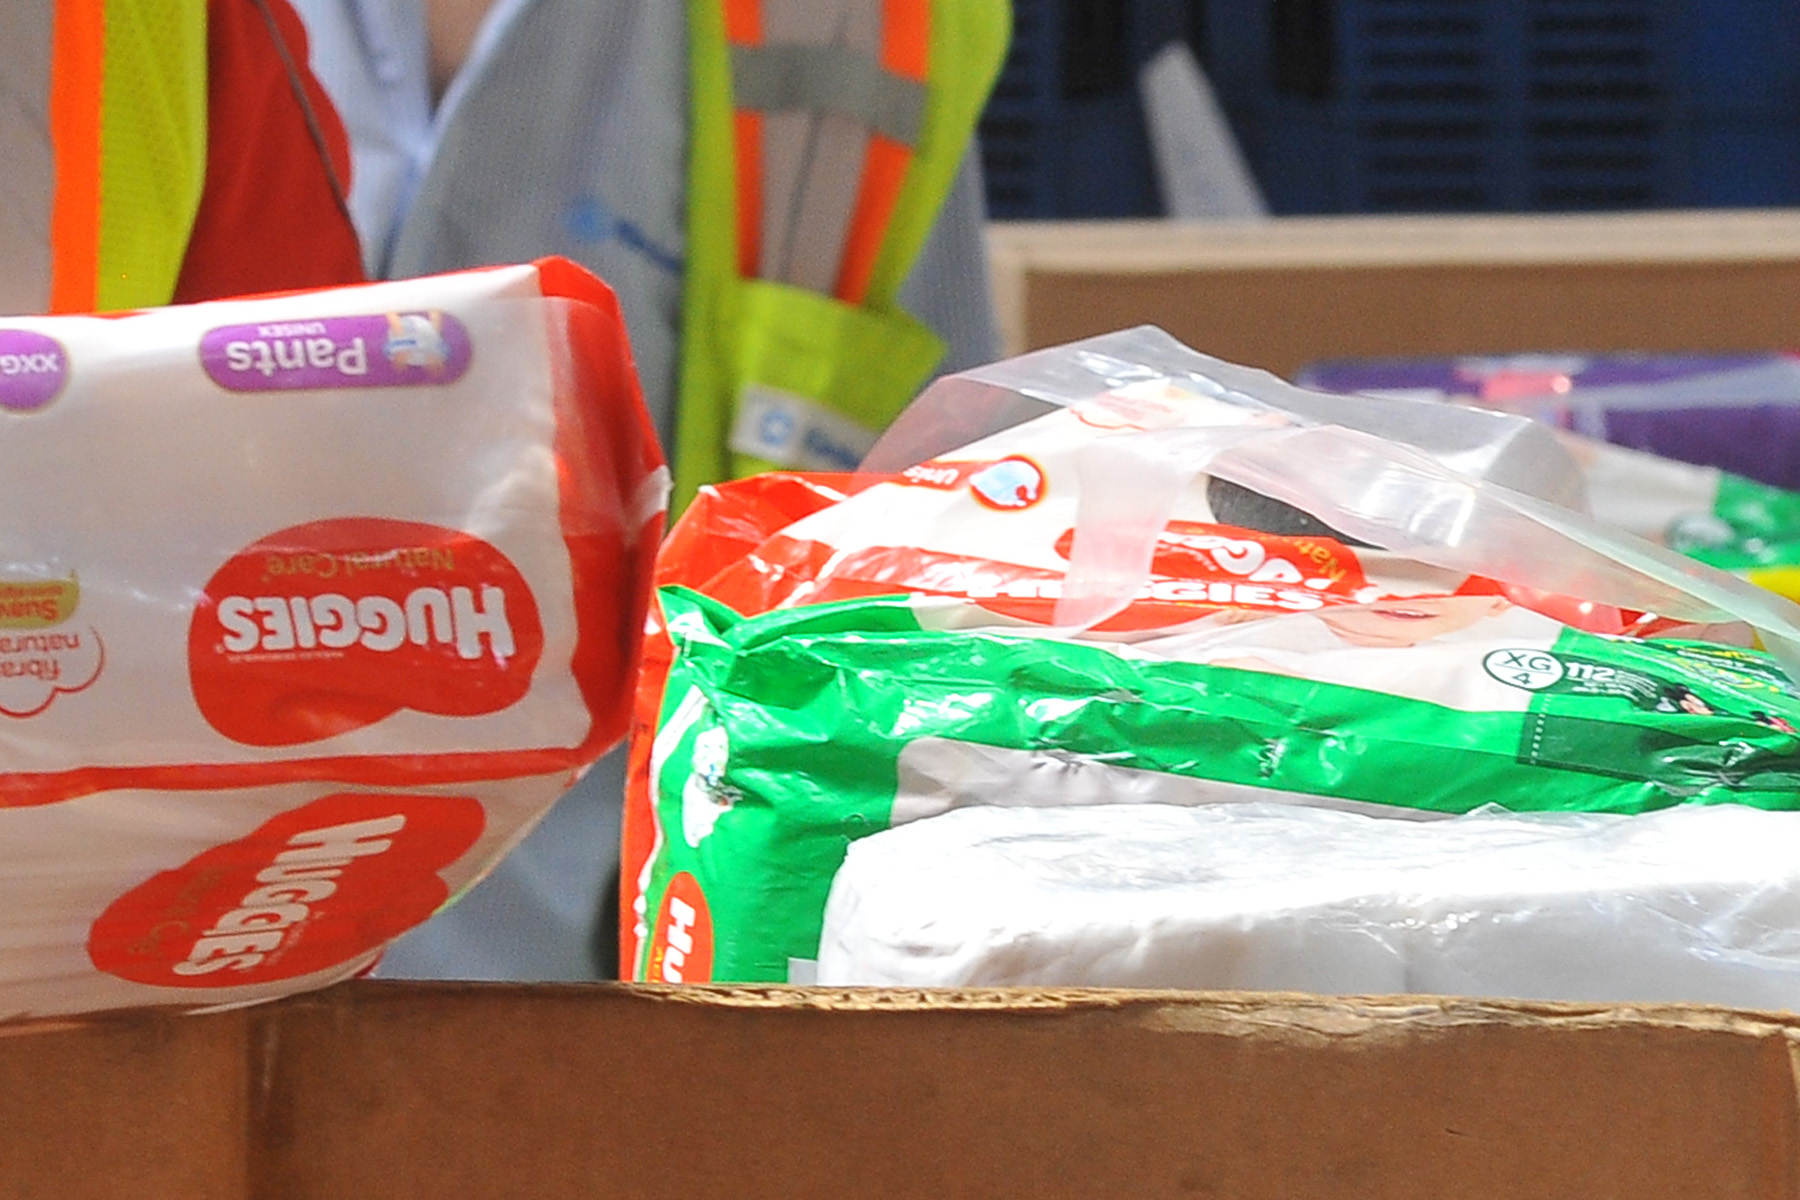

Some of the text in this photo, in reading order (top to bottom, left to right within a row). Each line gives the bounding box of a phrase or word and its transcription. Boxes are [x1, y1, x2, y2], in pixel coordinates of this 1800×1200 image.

[256, 322, 327, 338] UNISEX
[0, 352, 60, 378] XXG
[225, 337, 369, 377] Pants
[267, 546, 456, 580] Natural Care
[216, 585, 517, 661] HUGGIES
[1502, 651, 1553, 672] XG
[1566, 661, 1617, 682] 112
[1511, 671, 1532, 686] 4
[172, 812, 408, 977] HUGGIES
